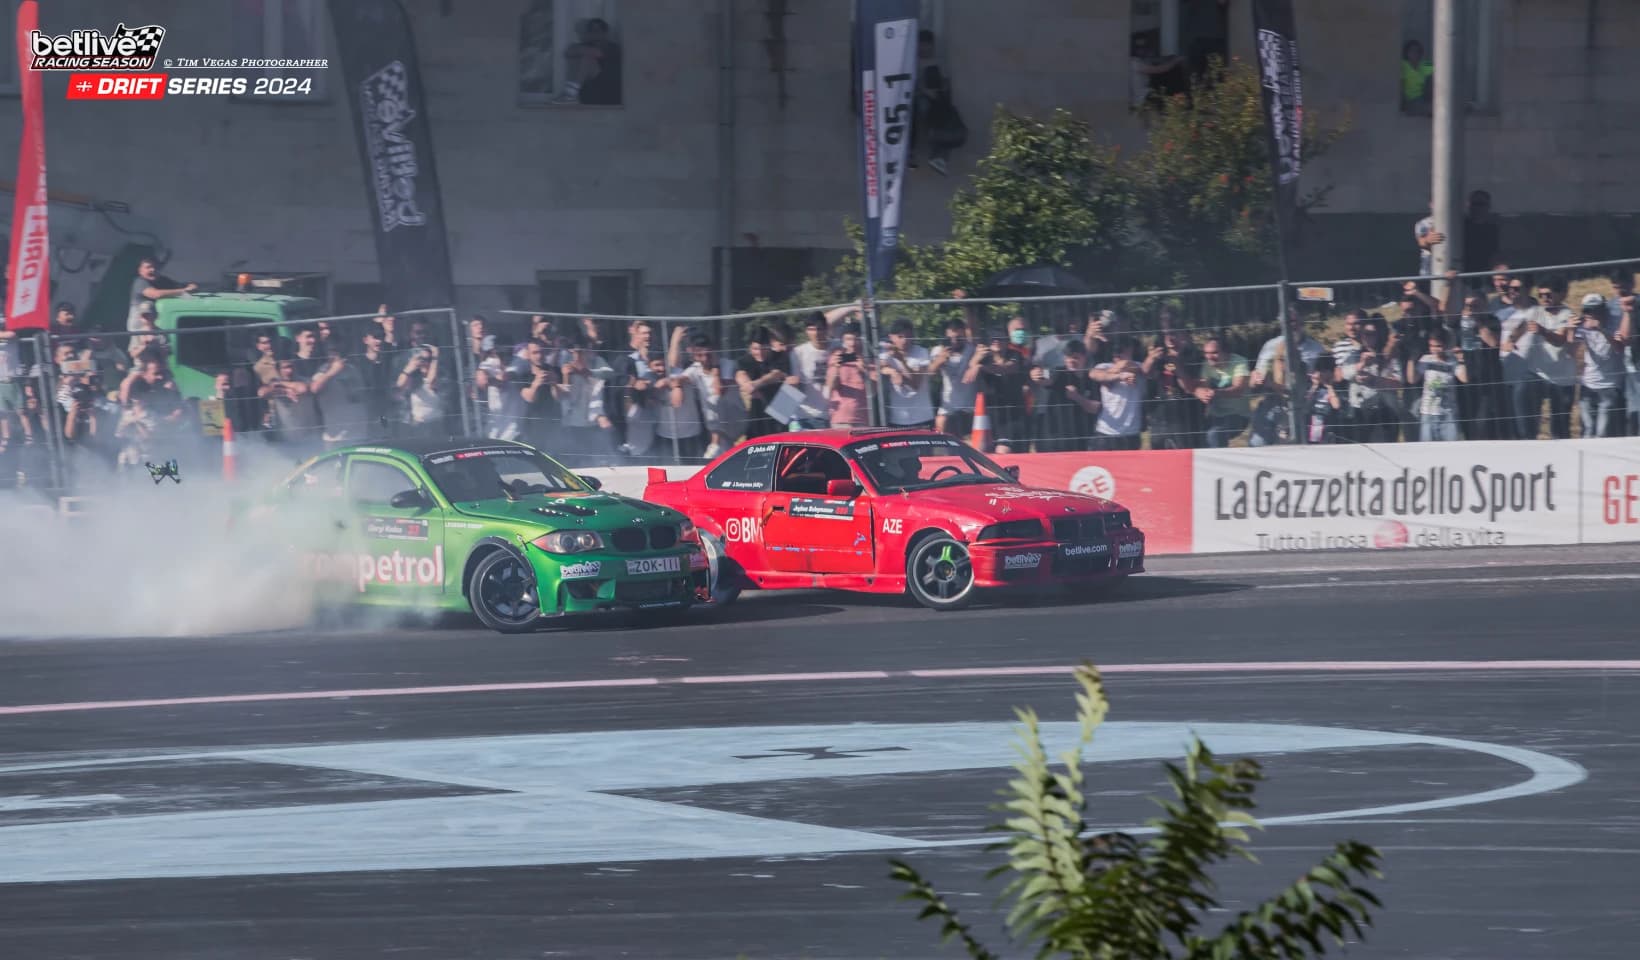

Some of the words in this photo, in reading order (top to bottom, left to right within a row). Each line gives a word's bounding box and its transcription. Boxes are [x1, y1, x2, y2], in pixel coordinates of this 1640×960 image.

[883, 72, 912, 145] 95.1
[1216, 478, 1248, 520] La
[1256, 470, 1384, 518] Gazzetta
[1393, 467, 1464, 515] dello
[1470, 464, 1556, 522] Sport
[883, 518, 903, 534] AZE
[1415, 528, 1464, 547] della
[1468, 528, 1504, 546] vita
[1065, 544, 1107, 556] betlive.com
